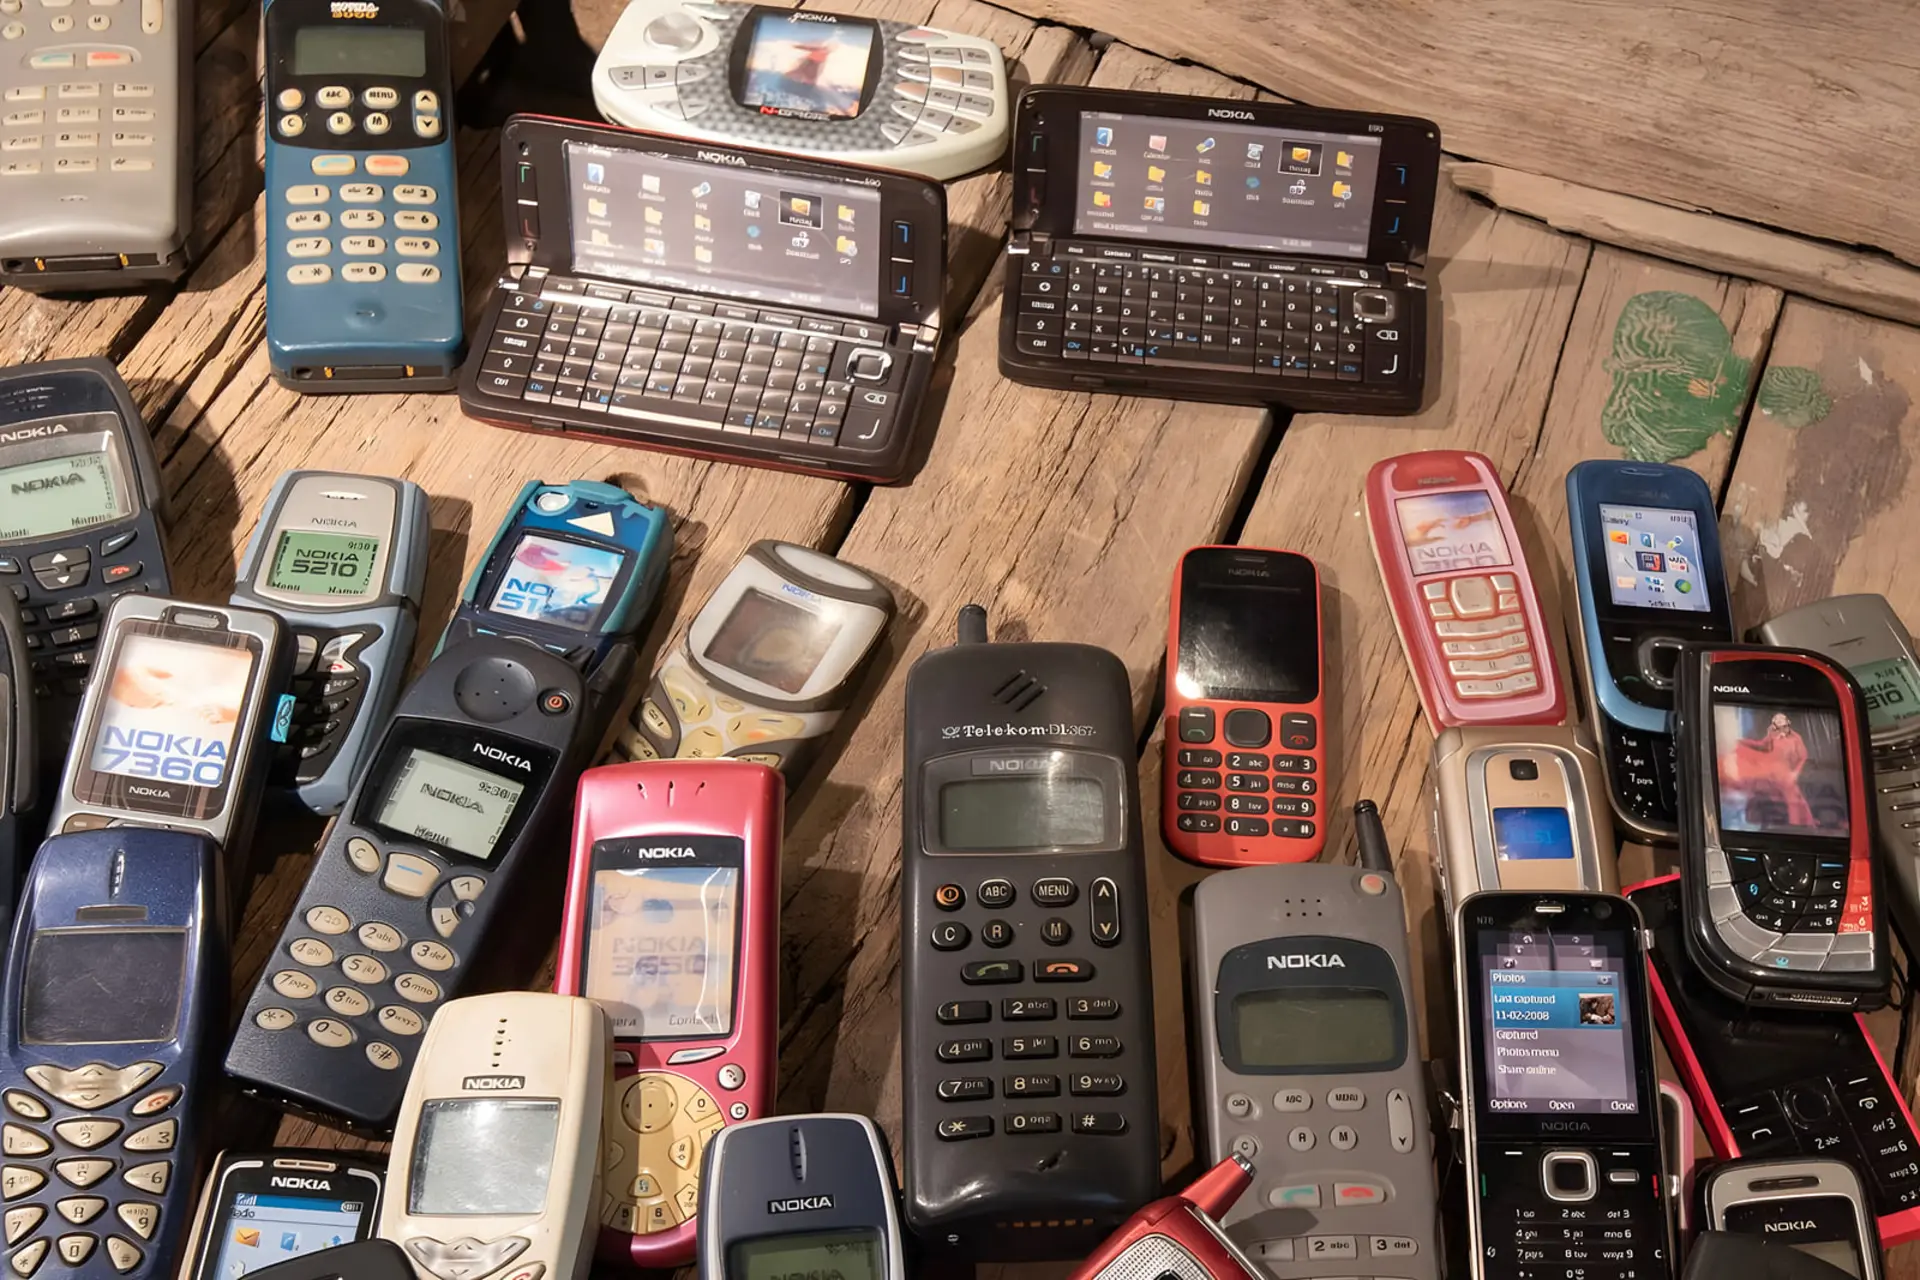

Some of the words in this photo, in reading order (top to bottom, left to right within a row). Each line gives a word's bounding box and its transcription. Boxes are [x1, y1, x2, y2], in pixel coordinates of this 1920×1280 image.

[1207, 108, 1255, 121] NOKIA
[697, 150, 748, 167] NOKIA
[0, 423, 68, 443] NOKIA
[11, 472, 85, 495] NOKIA
[311, 517, 358, 528] NOKIA
[295, 548, 360, 562] NOKIA
[1417, 541, 1493, 559] NOKIA
[290, 559, 358, 578] 5210
[1713, 685, 1750, 693] NOKIA
[102, 725, 228, 761] NOKIA
[472, 742, 533, 772] NOKIA
[101, 746, 225, 786] 7360
[128, 785, 171, 798] NOKIA
[419, 782, 485, 814] NOKIA
[638, 847, 696, 859] NOKIA
[985, 885, 1008, 897] ABC
[1038, 885, 1070, 897] MENU
[1832, 881, 1841, 890] C
[944, 926, 956, 941] C
[991, 924, 1002, 938] R
[1050, 922, 1062, 937] M
[613, 936, 706, 954] NOKIA
[1266, 953, 1346, 970] NOKIA
[1492, 973, 1526, 984] Photos
[1077, 999, 1089, 1013] 3
[1494, 994, 1512, 1005] Last
[1514, 994, 1556, 1005] captured
[950, 1003, 960, 1017] 1
[1012, 1001, 1024, 1015] 2
[1495, 1010, 1549, 1021] 11-02-2008
[1496, 1030, 1539, 1041] Captured
[949, 1042, 960, 1056] 4
[1012, 1039, 1025, 1052] 5
[1079, 1037, 1091, 1051] 6
[1497, 1047, 1531, 1058] Photos
[1531, 1049, 1559, 1058] menu
[1498, 1065, 1525, 1075] Share
[1526, 1065, 1557, 1075] online
[464, 1077, 523, 1090] NOKIA
[950, 1080, 962, 1094] 7
[1014, 1076, 1026, 1090] 8
[1080, 1075, 1092, 1088] 9
[734, 1106, 744, 1116] C
[1490, 1099, 1528, 1111] Options
[1549, 1100, 1575, 1112] Open
[1610, 1101, 1635, 1111] Close
[1013, 1115, 1026, 1128] 0
[1082, 1114, 1095, 1127] #
[1541, 1121, 1591, 1131] NOKIA
[157, 1131, 171, 1145] 3
[1338, 1131, 1349, 1142] M
[151, 1171, 163, 1185] 6
[270, 1175, 332, 1191] NOKIA
[770, 1196, 833, 1213] NOKIA
[138, 1216, 150, 1230] 9
[1764, 1220, 1817, 1233] NOKIA
[1314, 1240, 1326, 1252] 2
[1376, 1238, 1388, 1251] 3
